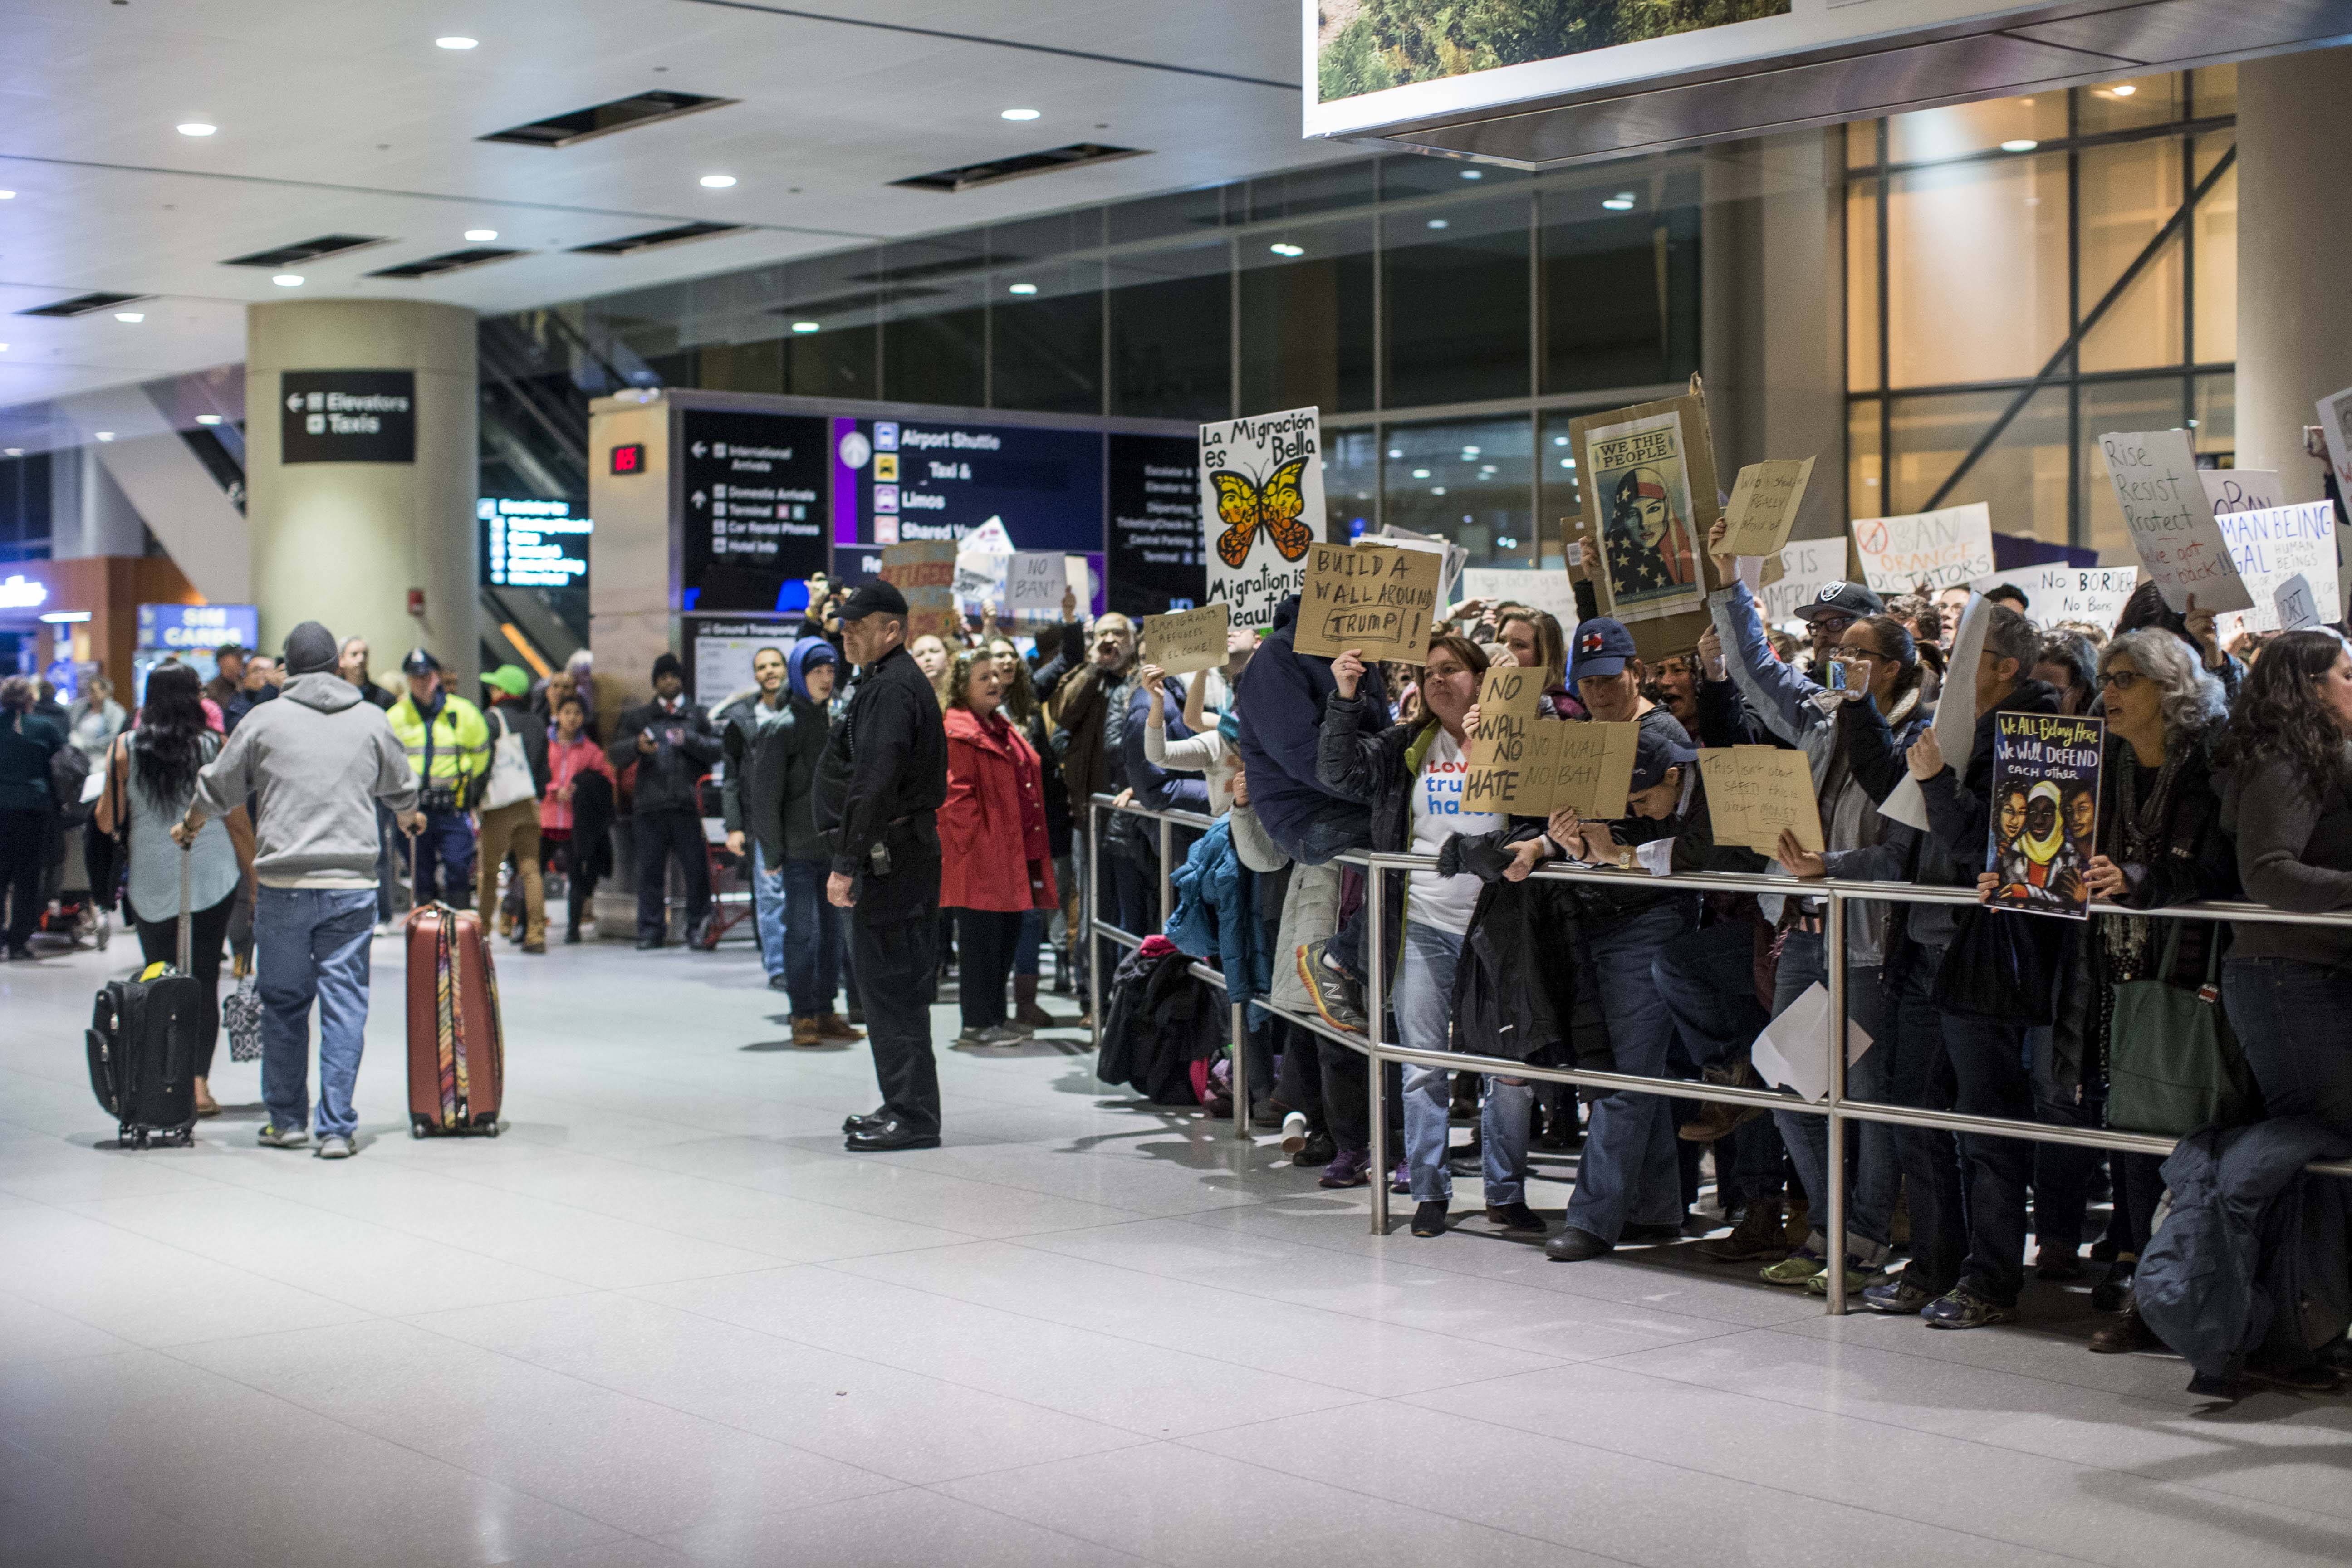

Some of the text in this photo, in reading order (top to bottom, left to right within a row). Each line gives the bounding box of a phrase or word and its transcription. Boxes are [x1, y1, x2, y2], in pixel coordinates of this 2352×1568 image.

[327, 392, 409, 412] Elevators
[327, 412, 380, 434] Taxis
[1202, 414, 1314, 449] La Migración
[901, 430, 1000, 451] Airport Shuttle
[1205, 431, 1316, 468] es Bella
[1599, 433, 1665, 456] WE THE
[1603, 445, 1667, 467] PEOPLE
[2105, 440, 2152, 468] Rise
[929, 461, 971, 479] Taxi &
[2116, 468, 2179, 501] Resist
[902, 492, 945, 509] Limos
[2124, 504, 2193, 533] Protect
[2220, 513, 2268, 544] MAN
[901, 522, 952, 540] Shared
[1888, 511, 1961, 553] BAN
[1881, 541, 1975, 572] ORANGE
[2274, 540, 2315, 554] HUMAN
[1027, 558, 1048, 575] NO
[1313, 550, 1409, 581] BUILD A
[1800, 548, 1818, 574] IS
[1868, 554, 1989, 590] DICTATORS
[1015, 579, 1055, 598] BAN!
[1207, 563, 1306, 608] Migration is
[2042, 571, 2067, 589] No
[1315, 581, 1433, 609] WALL AROUND
[1759, 582, 1820, 617] AMERI
[2063, 596, 2080, 612] No
[182, 608, 227, 627] SIM
[1328, 612, 1397, 634] TRUMP
[164, 627, 242, 647] CARDS
[1158, 627, 1203, 644] REFUGEES
[1487, 673, 1522, 702] NO
[1473, 714, 1526, 741] WALL
[1999, 717, 2017, 736] We
[2017, 716, 2039, 736] ALL
[2038, 718, 2073, 747] Belong
[1492, 739, 1524, 764] NO
[1530, 734, 1615, 759] NO WALL
[1997, 740, 2015, 760] We
[2016, 740, 2043, 762] Will
[1426, 776, 1463, 793] tru
[1465, 769, 1519, 802] HATE
[1524, 765, 1599, 787] NO BAN
